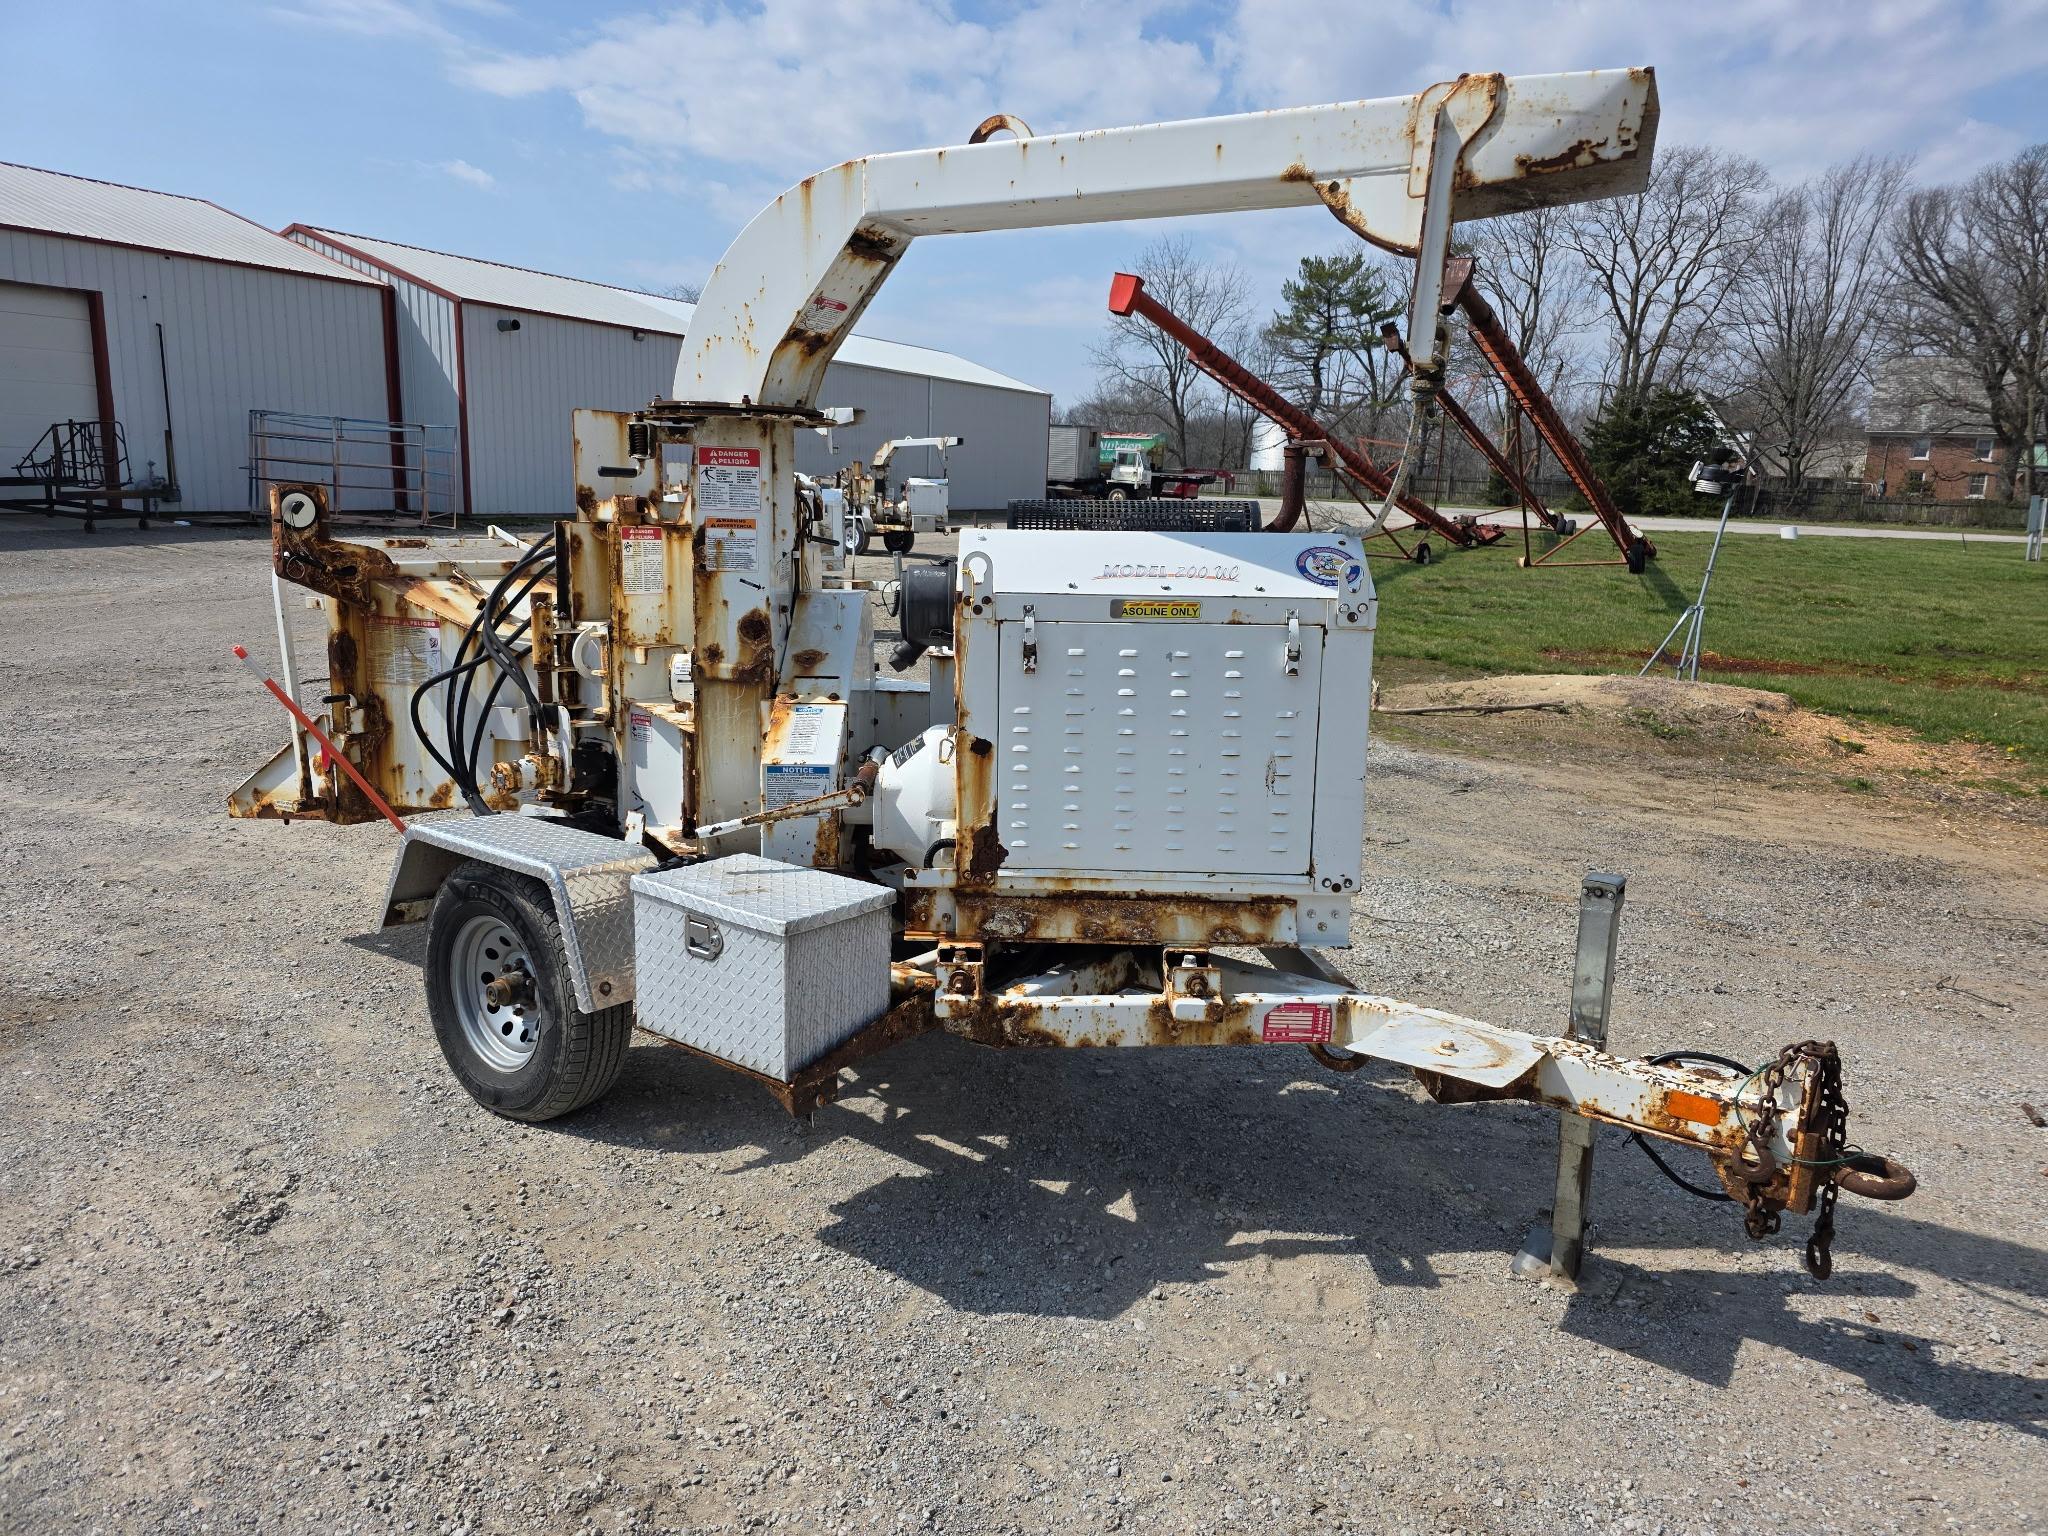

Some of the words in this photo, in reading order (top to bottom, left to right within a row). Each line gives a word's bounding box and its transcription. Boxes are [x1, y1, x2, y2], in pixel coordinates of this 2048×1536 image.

[1103, 564, 1168, 578] MODEL
[1174, 565, 1208, 579] 200
[1122, 607, 1168, 616] ASOLINE
[1170, 607, 1200, 616] ONLY
